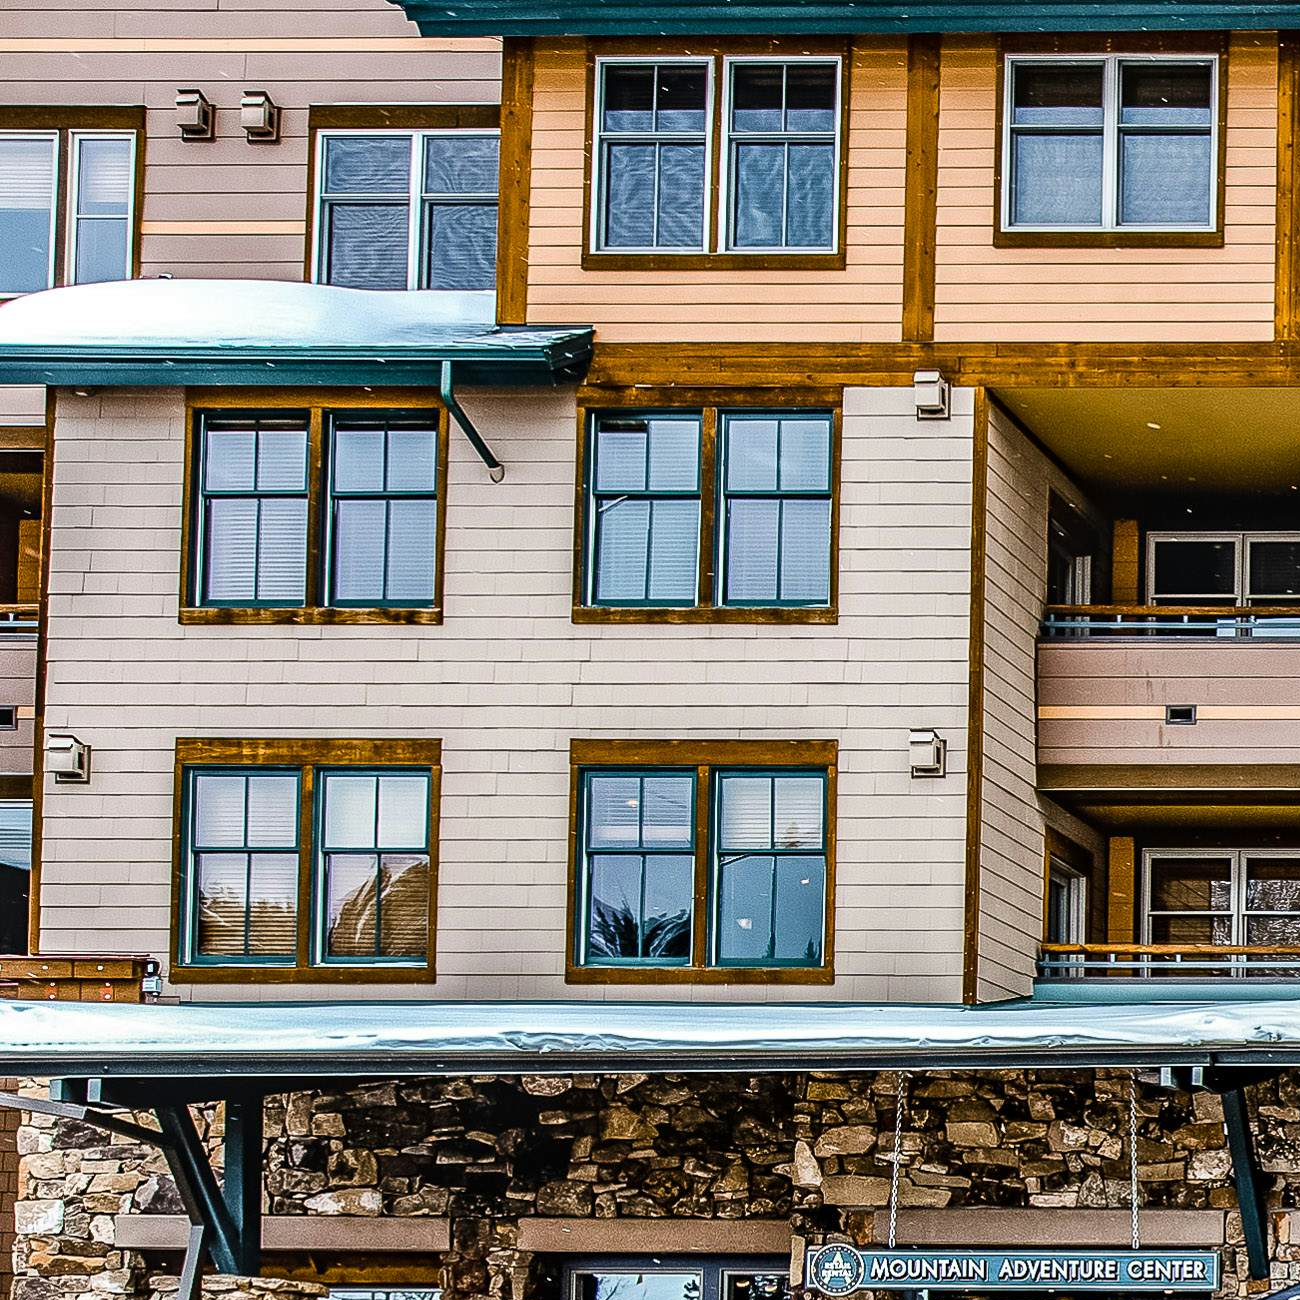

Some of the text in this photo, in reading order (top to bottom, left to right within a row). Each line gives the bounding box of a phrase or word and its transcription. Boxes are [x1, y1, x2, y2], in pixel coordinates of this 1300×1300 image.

[822, 1269, 853, 1278] RENTAL
[870, 1257, 1207, 1281] MOUNTAIN ADVENTURE CENTER
